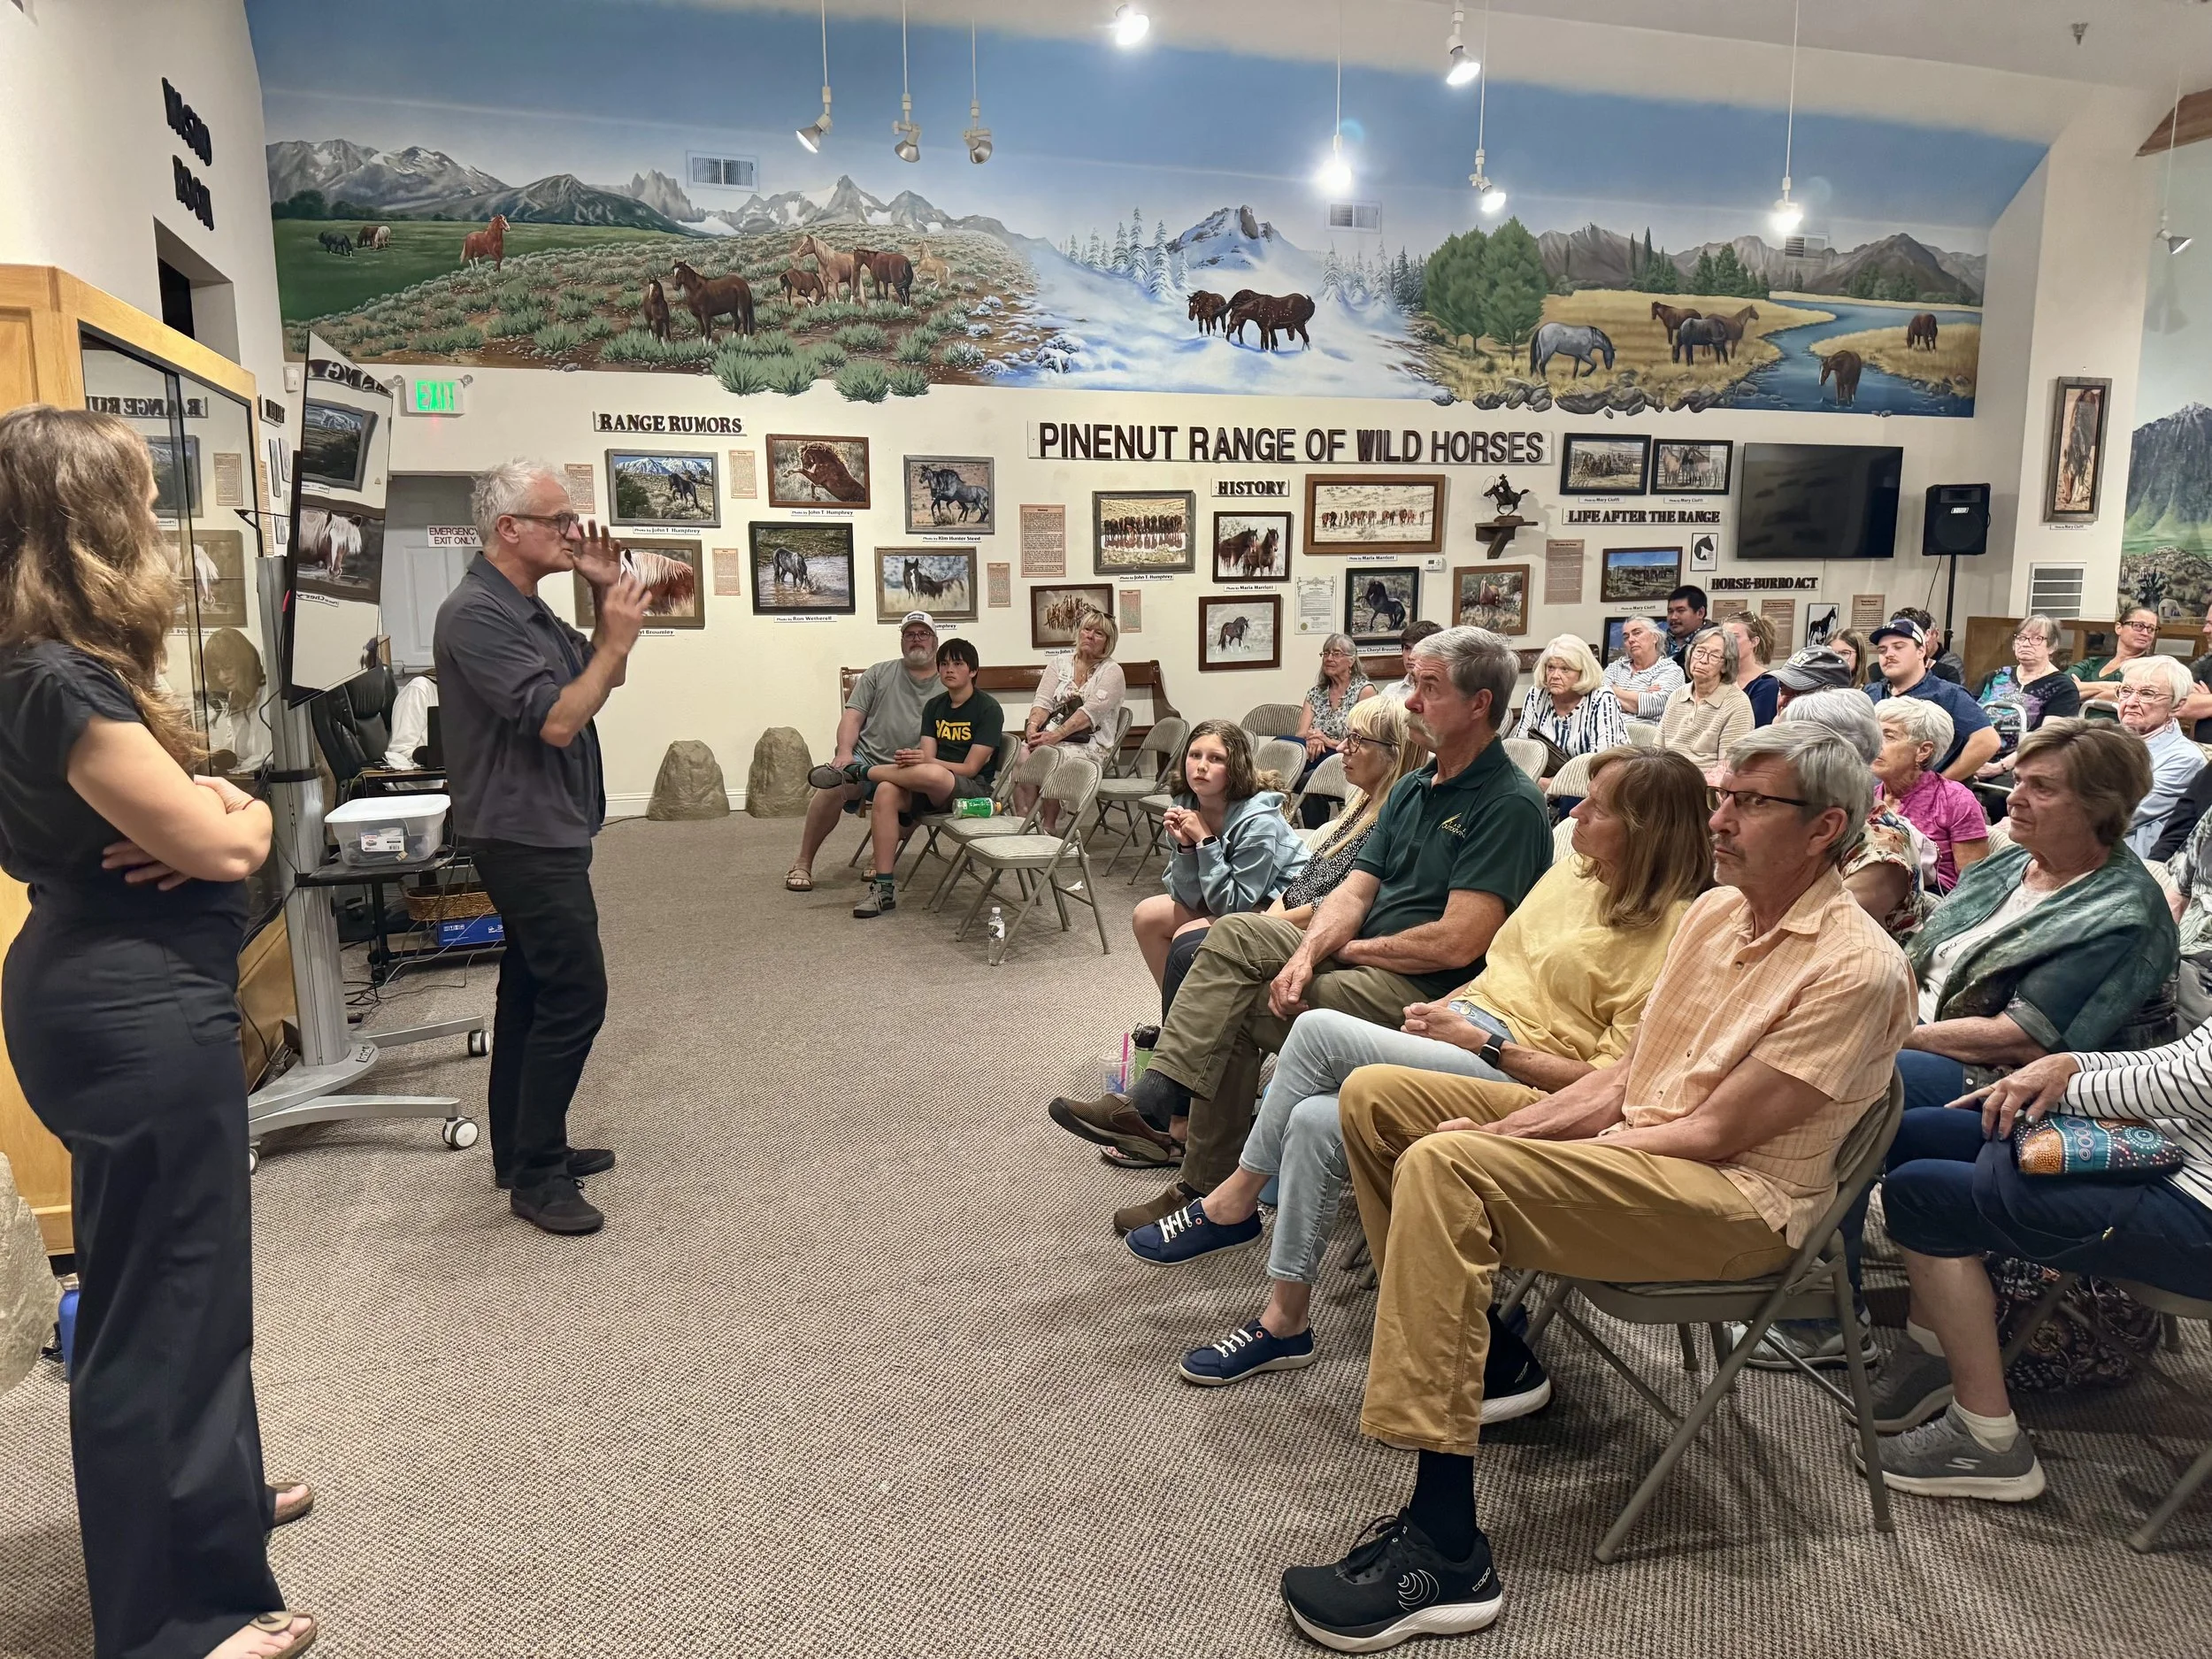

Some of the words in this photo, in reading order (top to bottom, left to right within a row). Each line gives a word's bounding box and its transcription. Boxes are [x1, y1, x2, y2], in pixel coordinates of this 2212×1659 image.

[415, 380, 456, 411] EXIT
[599, 413, 665, 431] RANGE
[668, 415, 742, 434] RUMORS
[1040, 422, 1179, 460] PINENUT
[1189, 426, 1296, 461] RANGE
[1305, 428, 1346, 462] OF
[1356, 429, 1422, 462] WILD
[1432, 430, 1544, 463] HORSES
[1217, 480, 1286, 495] HISTORY
[1568, 510, 1601, 523] LIFE
[1601, 510, 1647, 523] AFTER
[1648, 510, 1676, 523] THE
[1677, 510, 1720, 523] RANGE
[434, 535, 452, 545] EXIT
[454, 535, 476, 545] ONLY
[1793, 577, 1818, 589] ACT
[935, 718, 972, 741] VANS
[1471, 1566, 1491, 1592] topo
